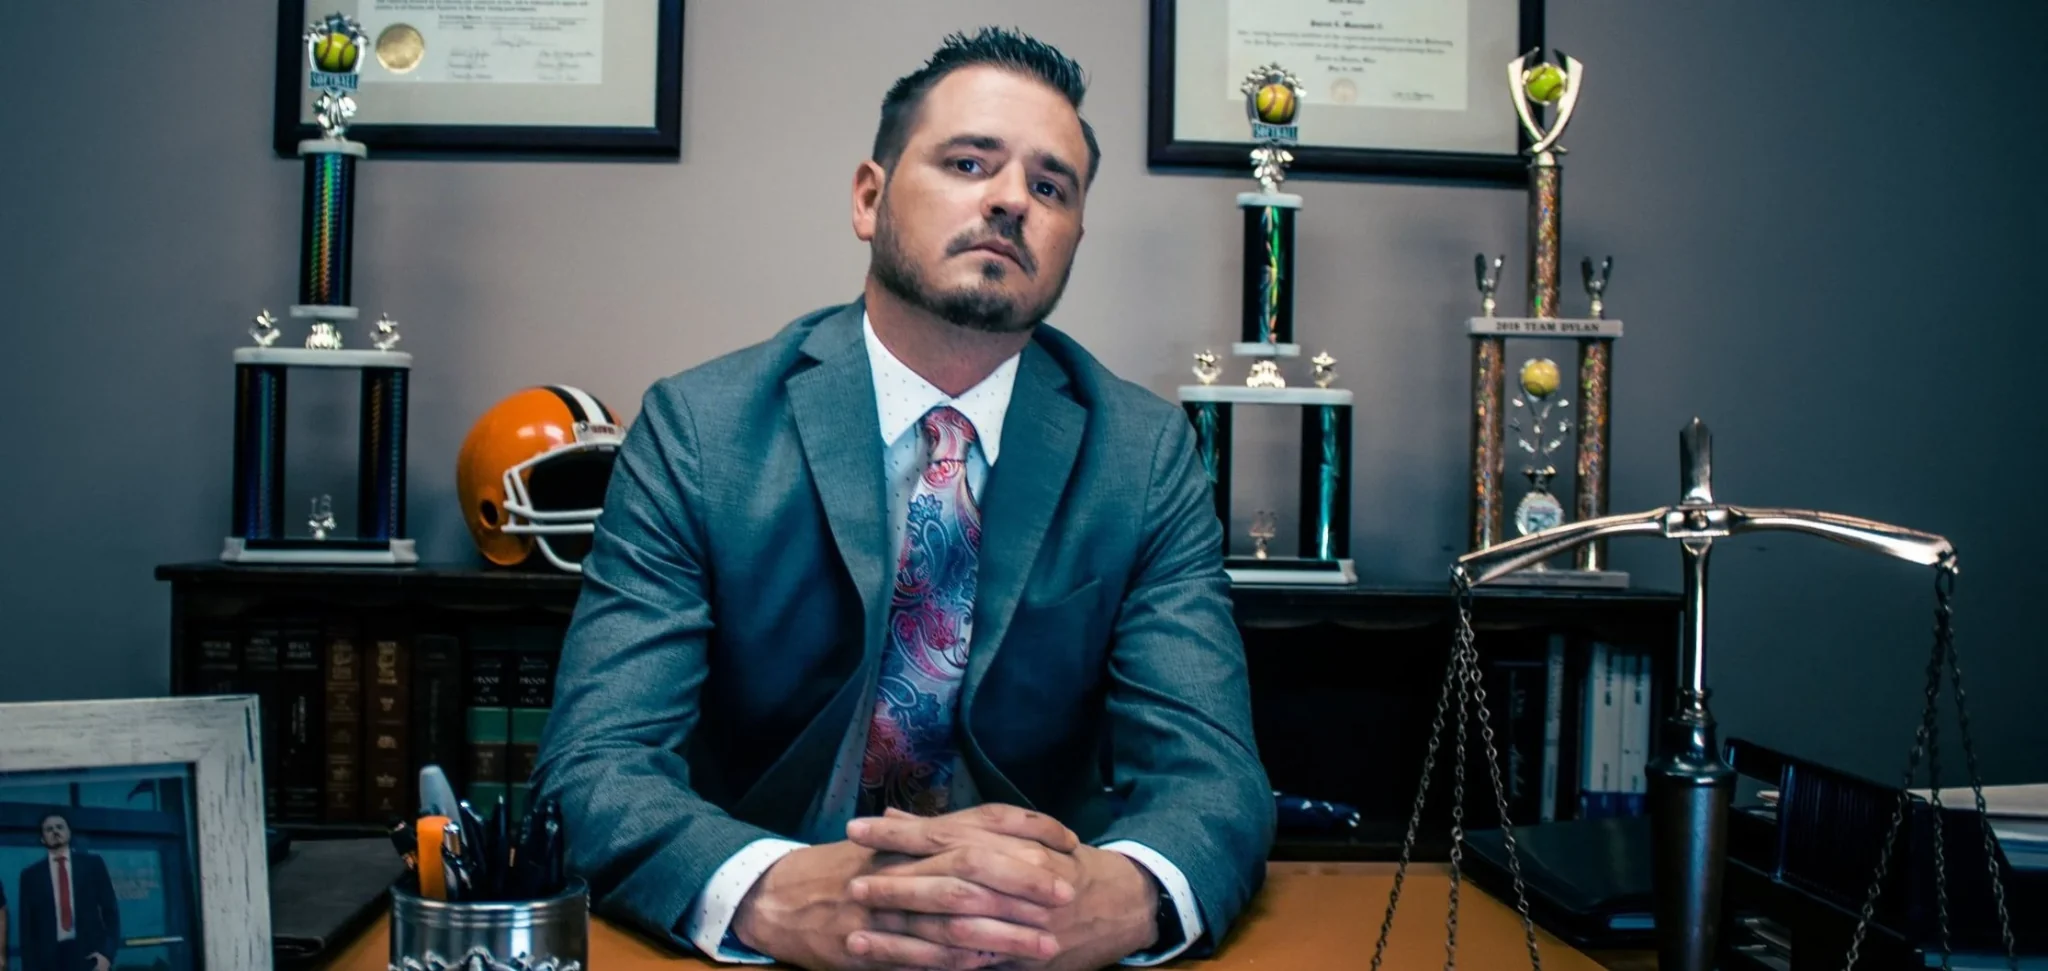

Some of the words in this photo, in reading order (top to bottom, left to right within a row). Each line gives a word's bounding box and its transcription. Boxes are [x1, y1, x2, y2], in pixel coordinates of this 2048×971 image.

[311, 72, 357, 88] SOFTBALL
[1525, 322, 1556, 331] TEAM
[1561, 323, 1599, 332] DYLAN
